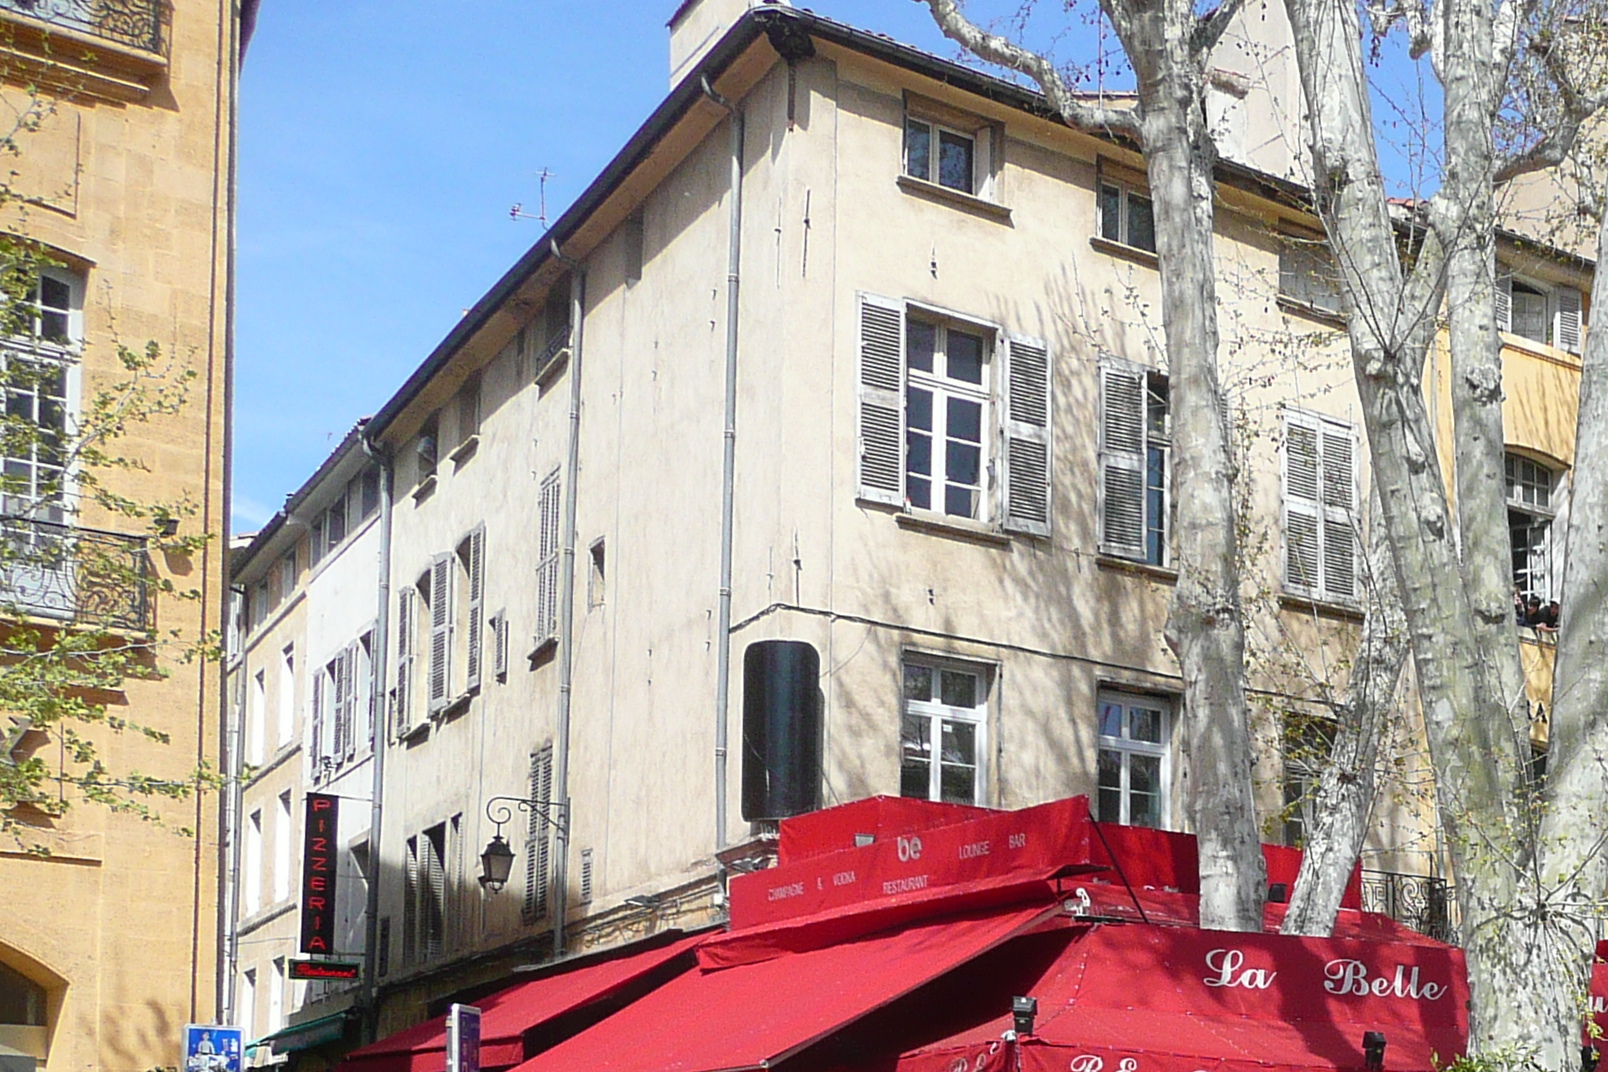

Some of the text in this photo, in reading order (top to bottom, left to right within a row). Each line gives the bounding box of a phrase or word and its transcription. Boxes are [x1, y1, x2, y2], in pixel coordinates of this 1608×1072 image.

[897, 836, 923, 862] be
[958, 833, 1026, 860] LOUNGE BAR
[308, 799, 331, 950] PIZZERIA
[768, 881, 804, 901] CHAMPAGNE
[833, 870, 856, 886] VODKA
[883, 875, 929, 895] RESTAURANT
[295, 962, 356, 978] Restaurant
[1203, 948, 1278, 990] La
[1323, 957, 1448, 1001] Belle
